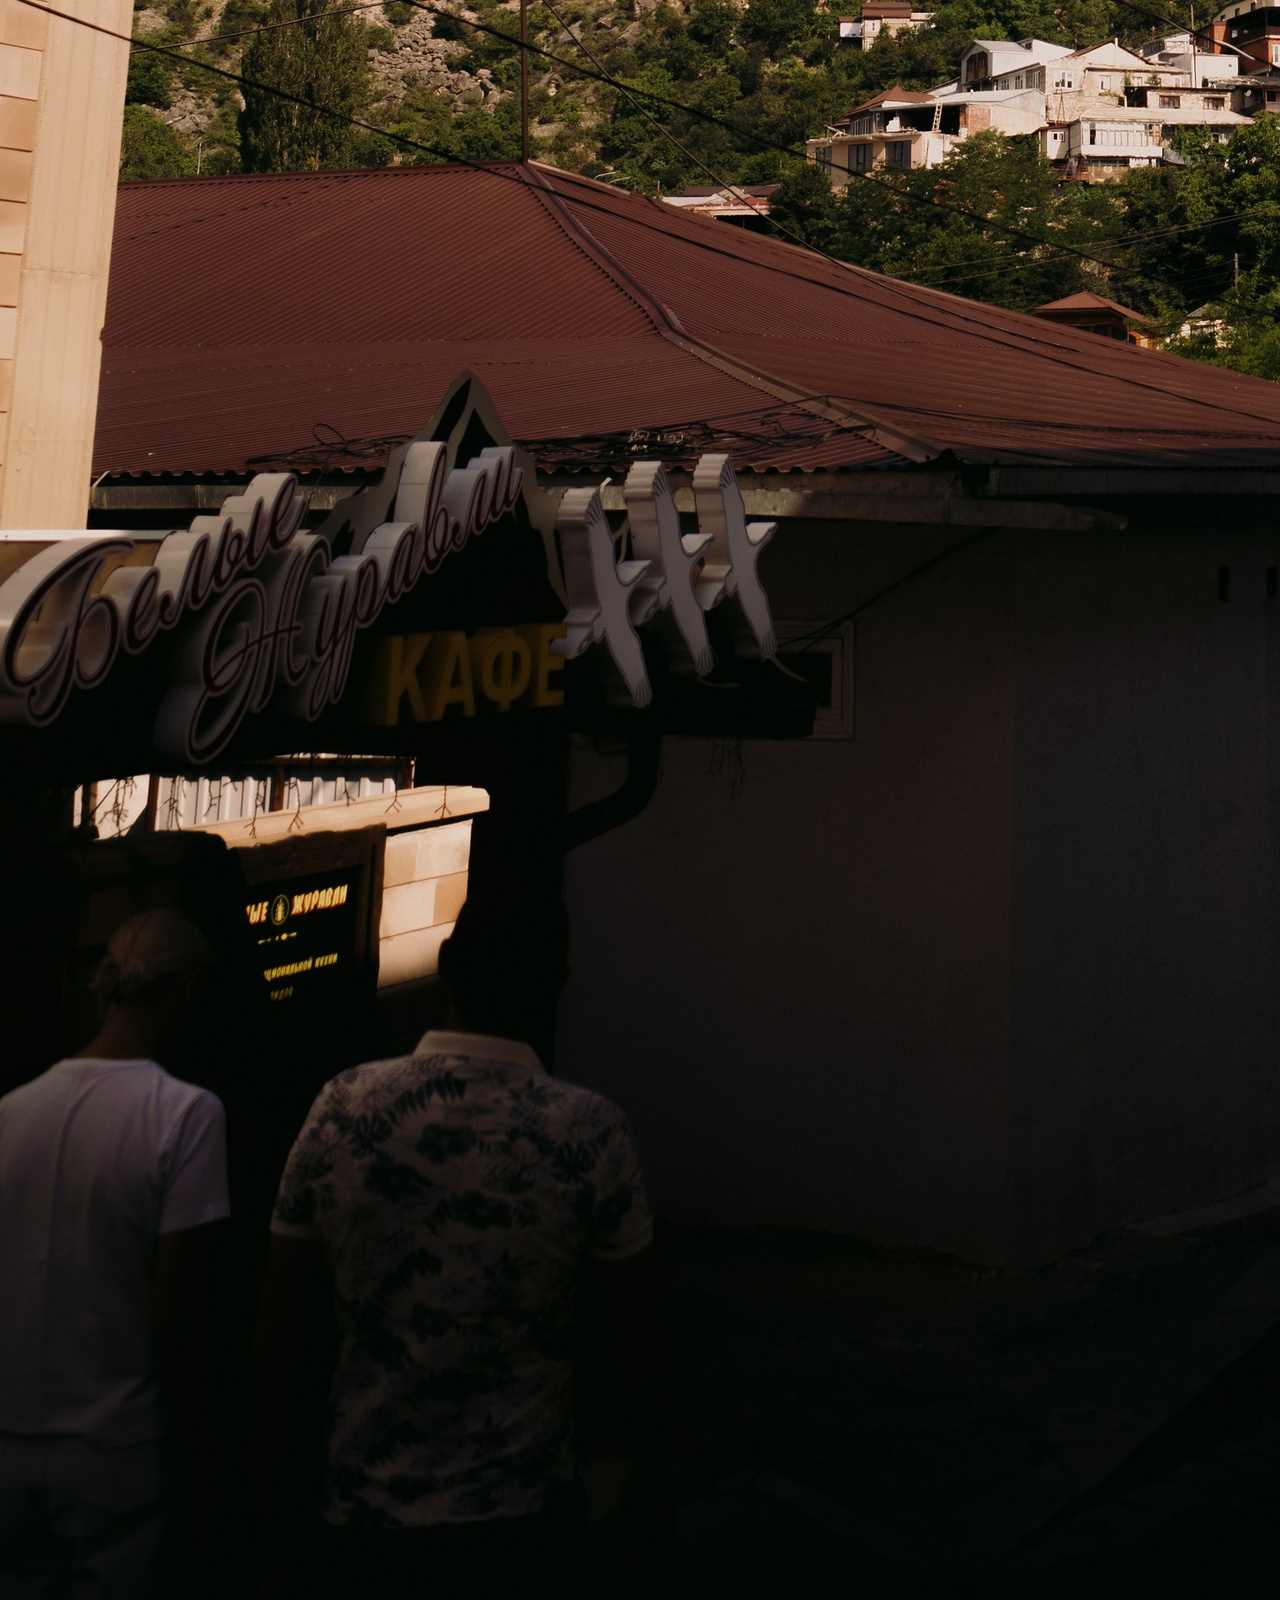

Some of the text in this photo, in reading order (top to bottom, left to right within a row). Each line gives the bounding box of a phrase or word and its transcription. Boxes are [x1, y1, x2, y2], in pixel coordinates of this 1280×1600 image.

[2, 472, 307, 728] Белые
[186, 443, 524, 764] Журавли
[380, 622, 567, 727] КАФЕ
[291, 884, 348, 916] ЖУРАВЛИ
